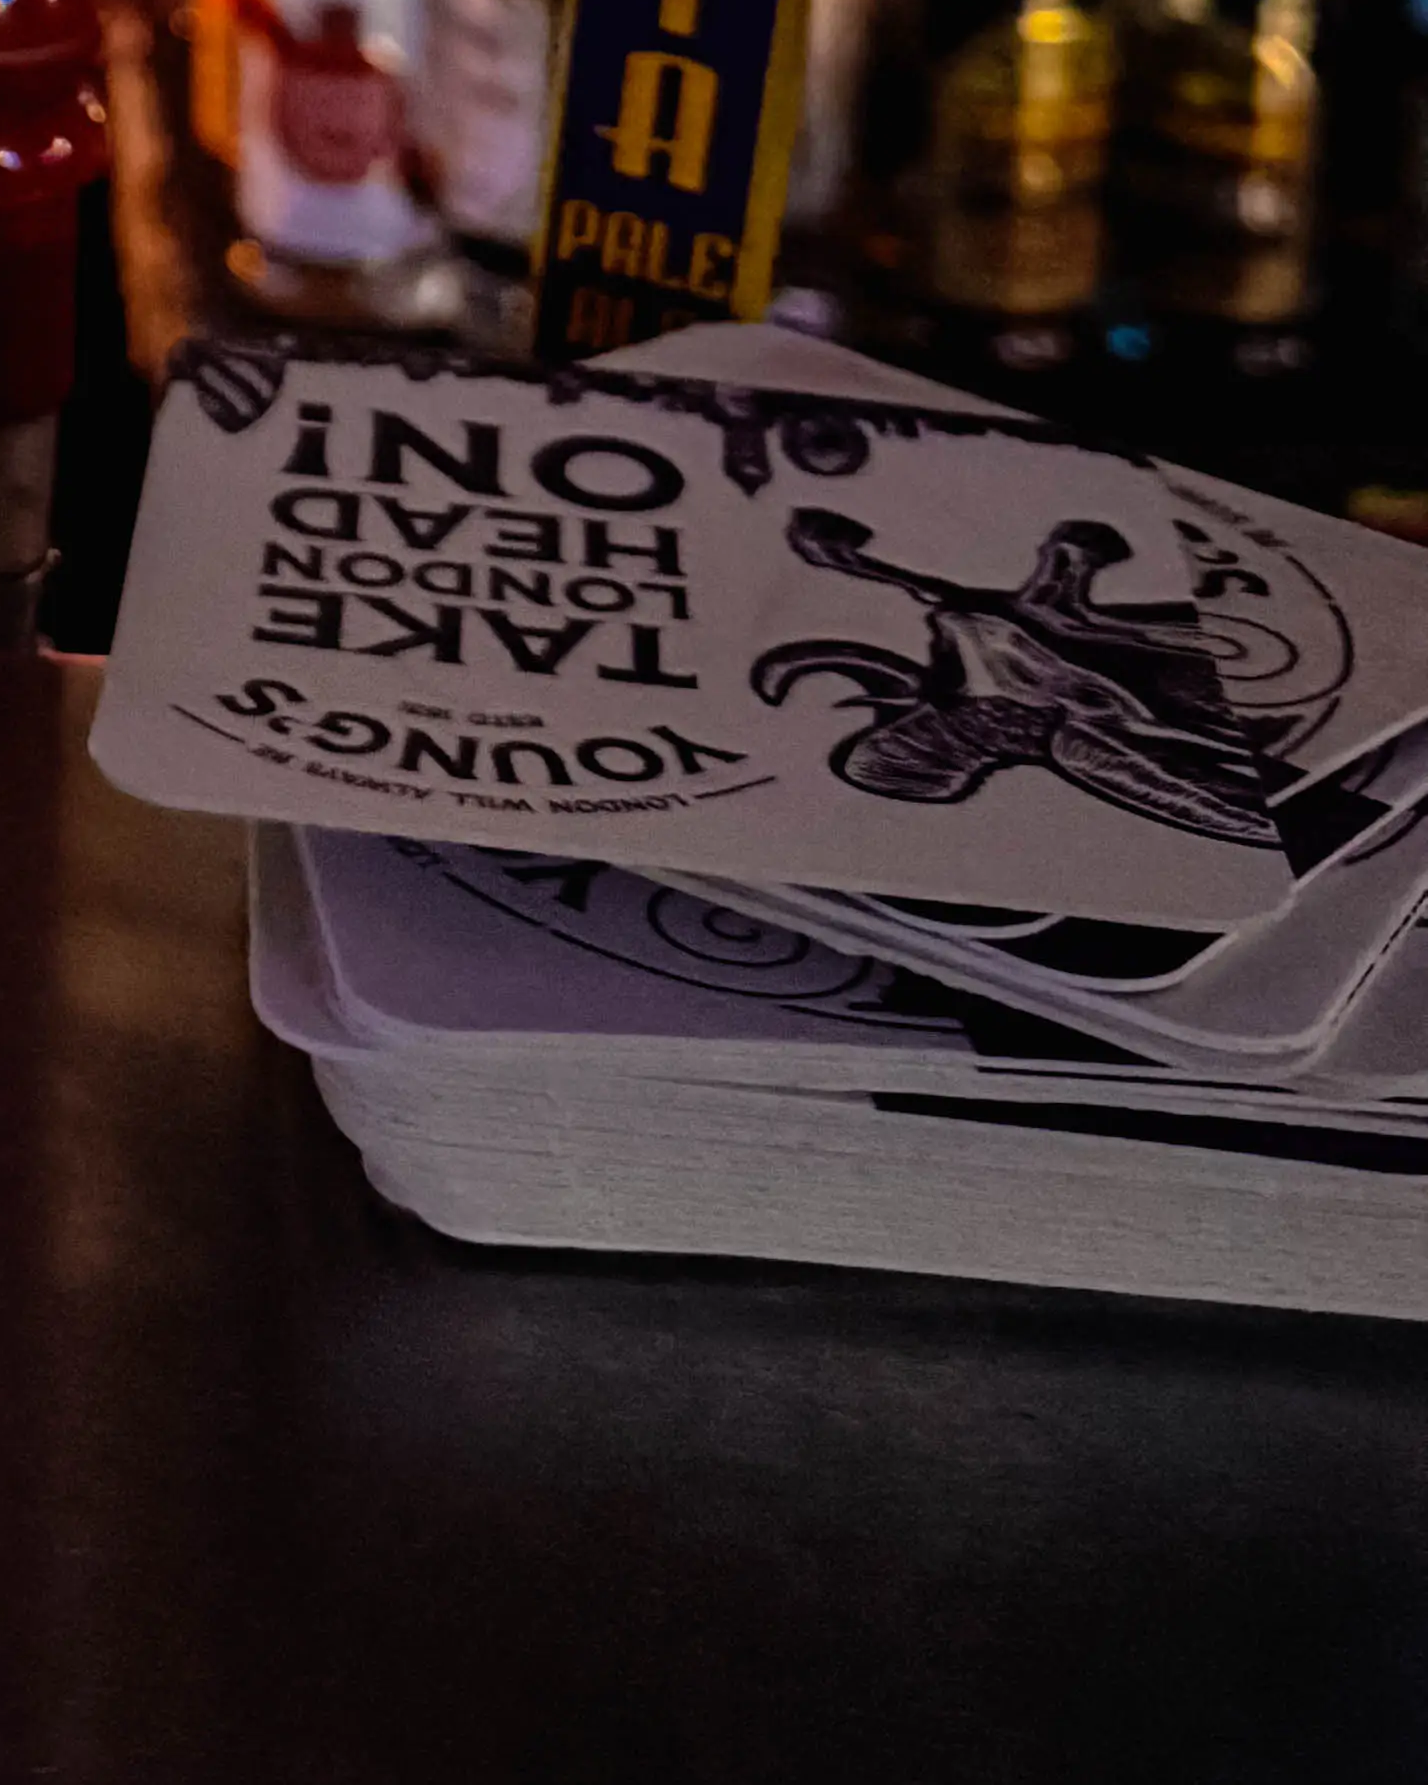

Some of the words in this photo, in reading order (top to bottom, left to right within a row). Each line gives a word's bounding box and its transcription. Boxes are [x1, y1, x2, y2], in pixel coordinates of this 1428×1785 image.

[557, 199, 734, 301] PALE
[283, 403, 685, 513] ON!
[271, 488, 686, 577] HEAD
[261, 541, 692, 620] LONDON
[252, 583, 699, 690] TAKE
[216, 678, 748, 785] YOUNG'S
[453, 790, 536, 815] WILL
[548, 792, 688, 816] LONDON
